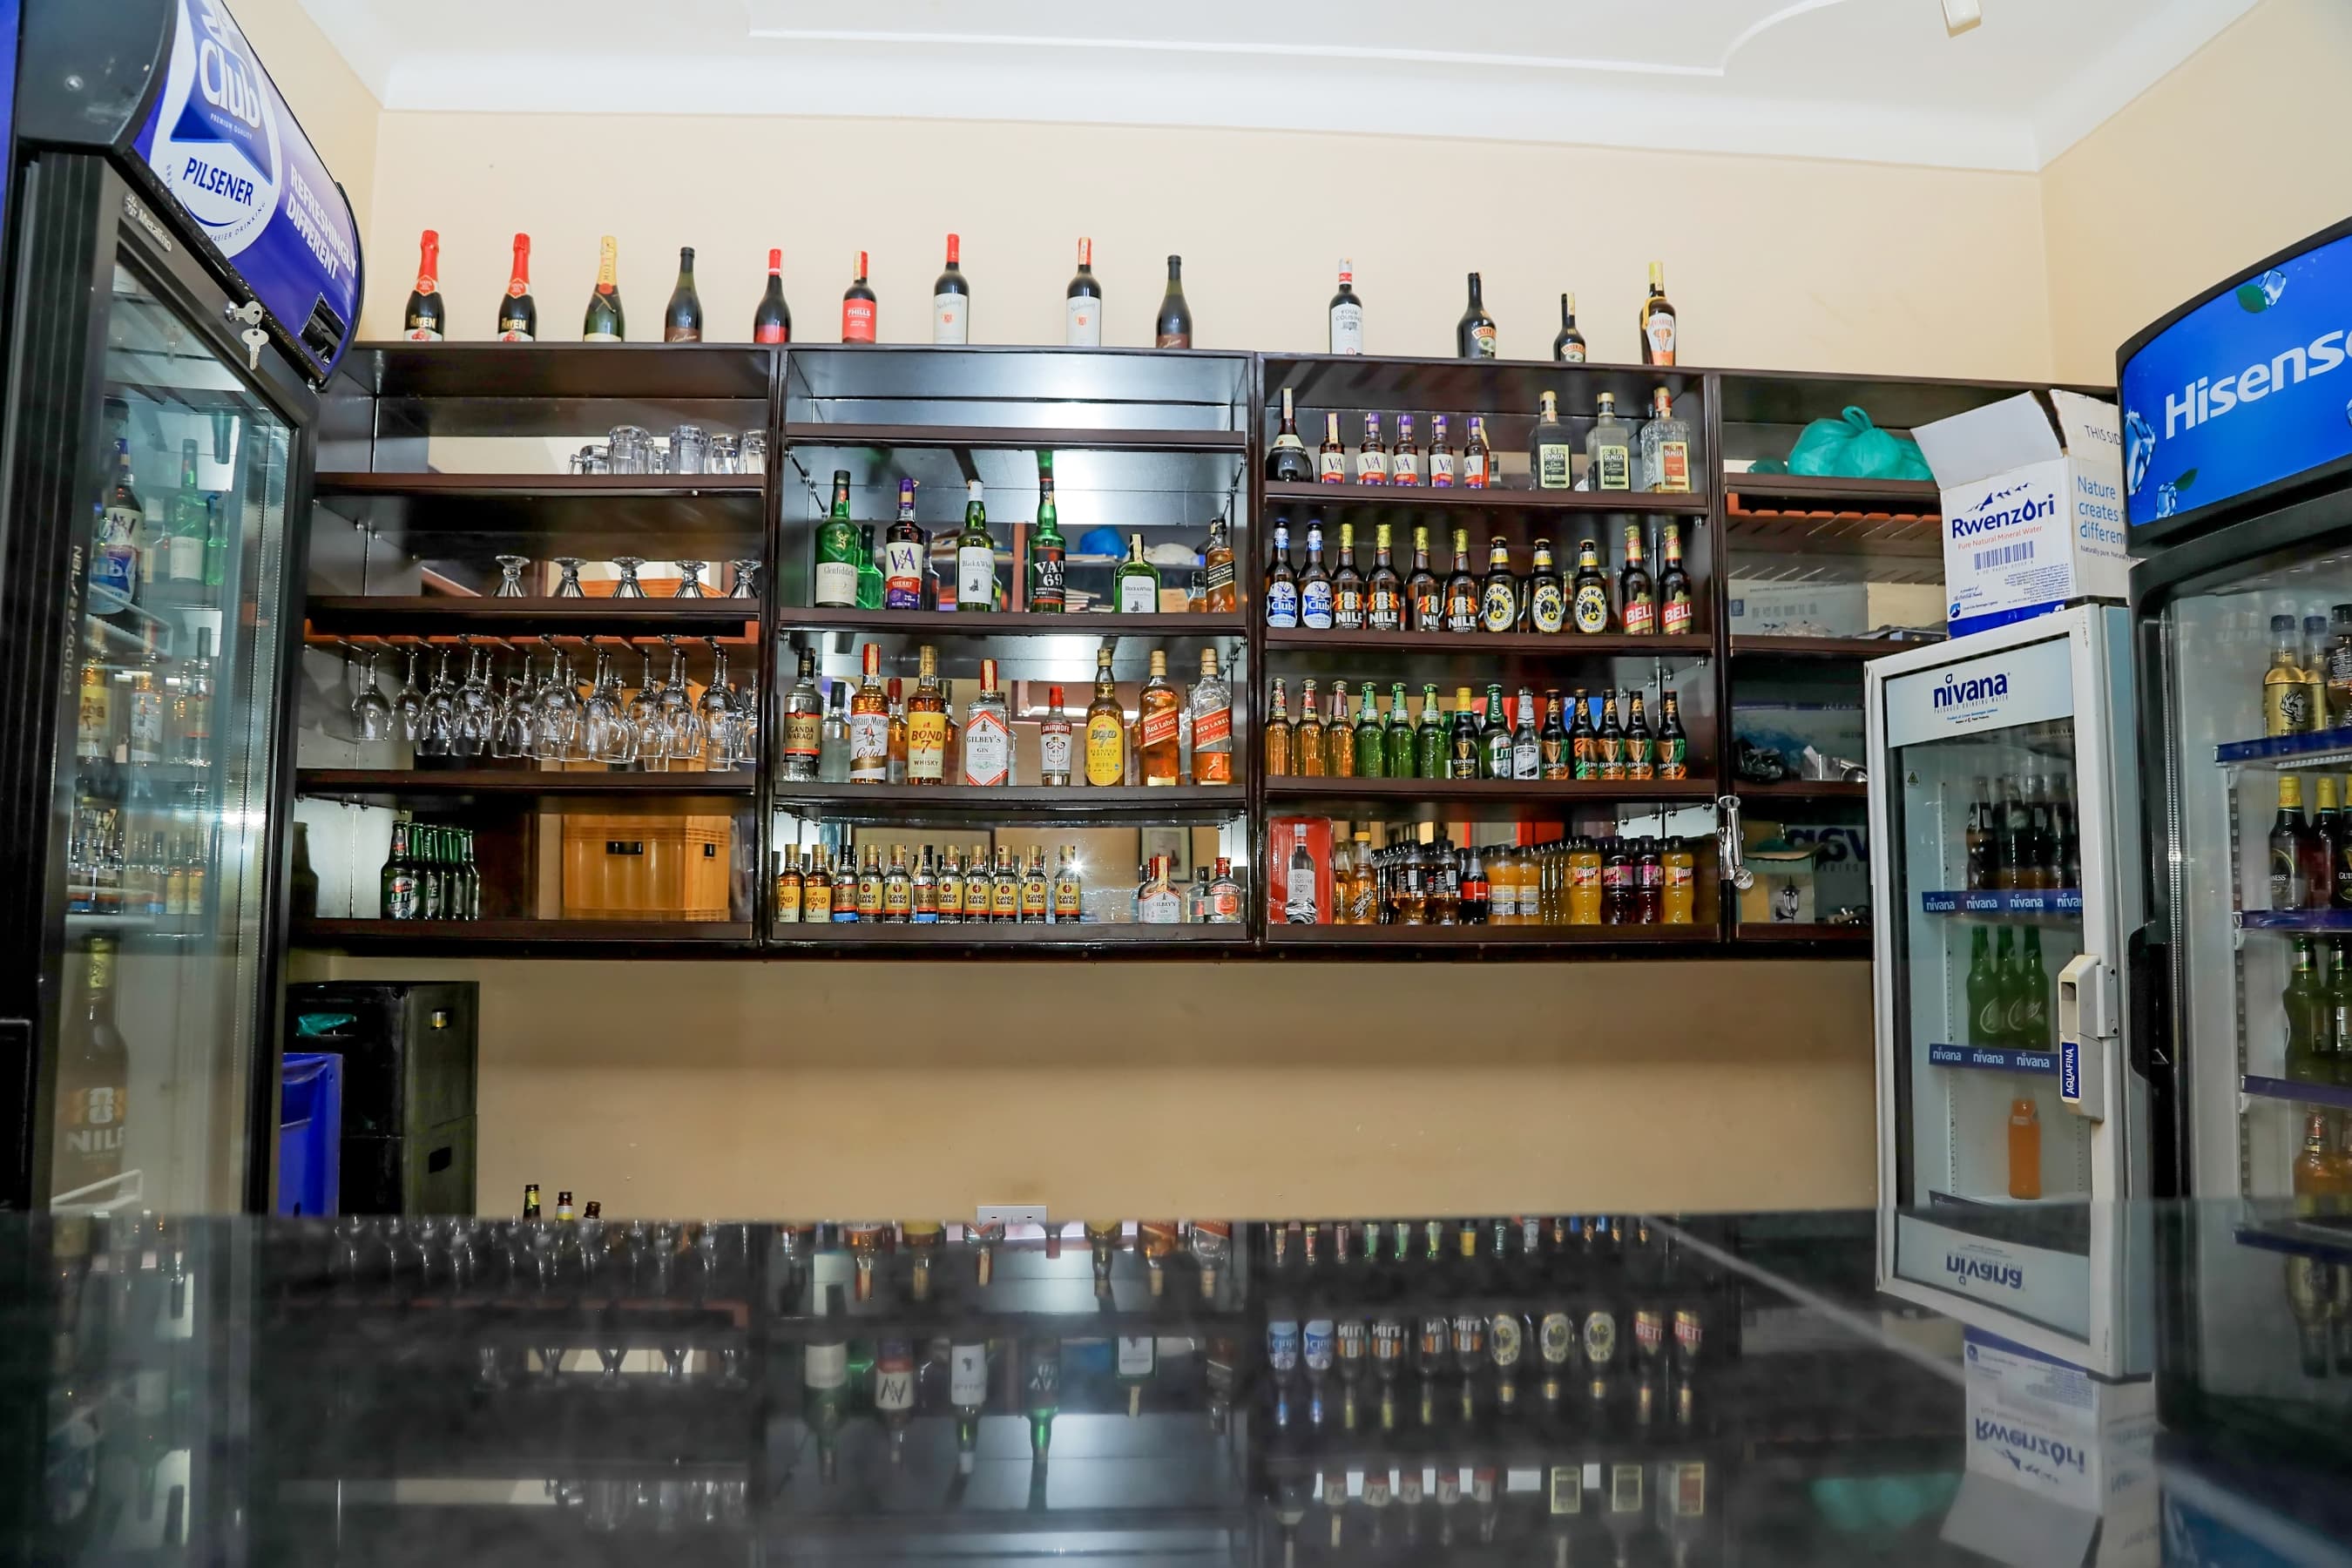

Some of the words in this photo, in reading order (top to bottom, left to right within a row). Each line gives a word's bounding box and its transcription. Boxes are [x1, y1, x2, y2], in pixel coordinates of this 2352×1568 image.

[199, 38, 260, 129] Club
[210, 112, 233, 131] PREMIUM
[233, 125, 253, 140] QUALITY
[182, 157, 253, 206] PILSENER
[234, 202, 266, 235] DRINKING
[291, 163, 356, 280] REFRESHINGLY
[286, 192, 339, 280] DIFFERENT
[2085, 425, 2106, 442] THIS
[2107, 431, 2122, 446] SID
[2078, 475, 2116, 500] Nature
[1951, 493, 2055, 539] Rwenzori
[2078, 501, 2119, 522] creates
[1957, 541, 1972, 551] Pure
[1972, 535, 1997, 546] Natural
[1997, 530, 2021, 541] Mineral
[2022, 525, 2043, 536] Water
[2079, 521, 2126, 544] differen
[1034, 560, 1064, 574] VAT
[1043, 573, 1063, 586] 69
[1483, 585, 1512, 605] TUSKER
[1577, 588, 1605, 607] TUSKER
[1271, 601, 1294, 611] Club
[1308, 600, 1330, 611] Club
[1626, 603, 1653, 625] BELL
[1665, 603, 1693, 625] BELL
[1335, 612, 1362, 624] NILE
[1369, 612, 1398, 624] NILE
[1448, 616, 1477, 628] NILE
[1934, 673, 2008, 708] nivana
[852, 715, 869, 727] aptain
[1146, 723, 1159, 733] Red
[1159, 717, 1176, 730] Label
[1196, 724, 1209, 733] RED
[1209, 717, 1230, 728] LABEL
[911, 730, 943, 741] BOND
[966, 734, 1001, 743] GILBEY'S
[1091, 728, 1117, 740] BOND
[856, 747, 881, 759] Gold
[921, 740, 931, 754] 7
[1493, 748, 1512, 760] LIT
[806, 896, 827, 904] BOND
[1926, 897, 1955, 911] nivana
[1966, 896, 1997, 909] nivana
[2010, 894, 2044, 908] nivana
[2058, 892, 2083, 908] niva
[1932, 1046, 1961, 1061] nivana
[1973, 1049, 2004, 1064] nivana
[2017, 1051, 2050, 1068] nivana
[2065, 1046, 2075, 1095] AQUAFINA
